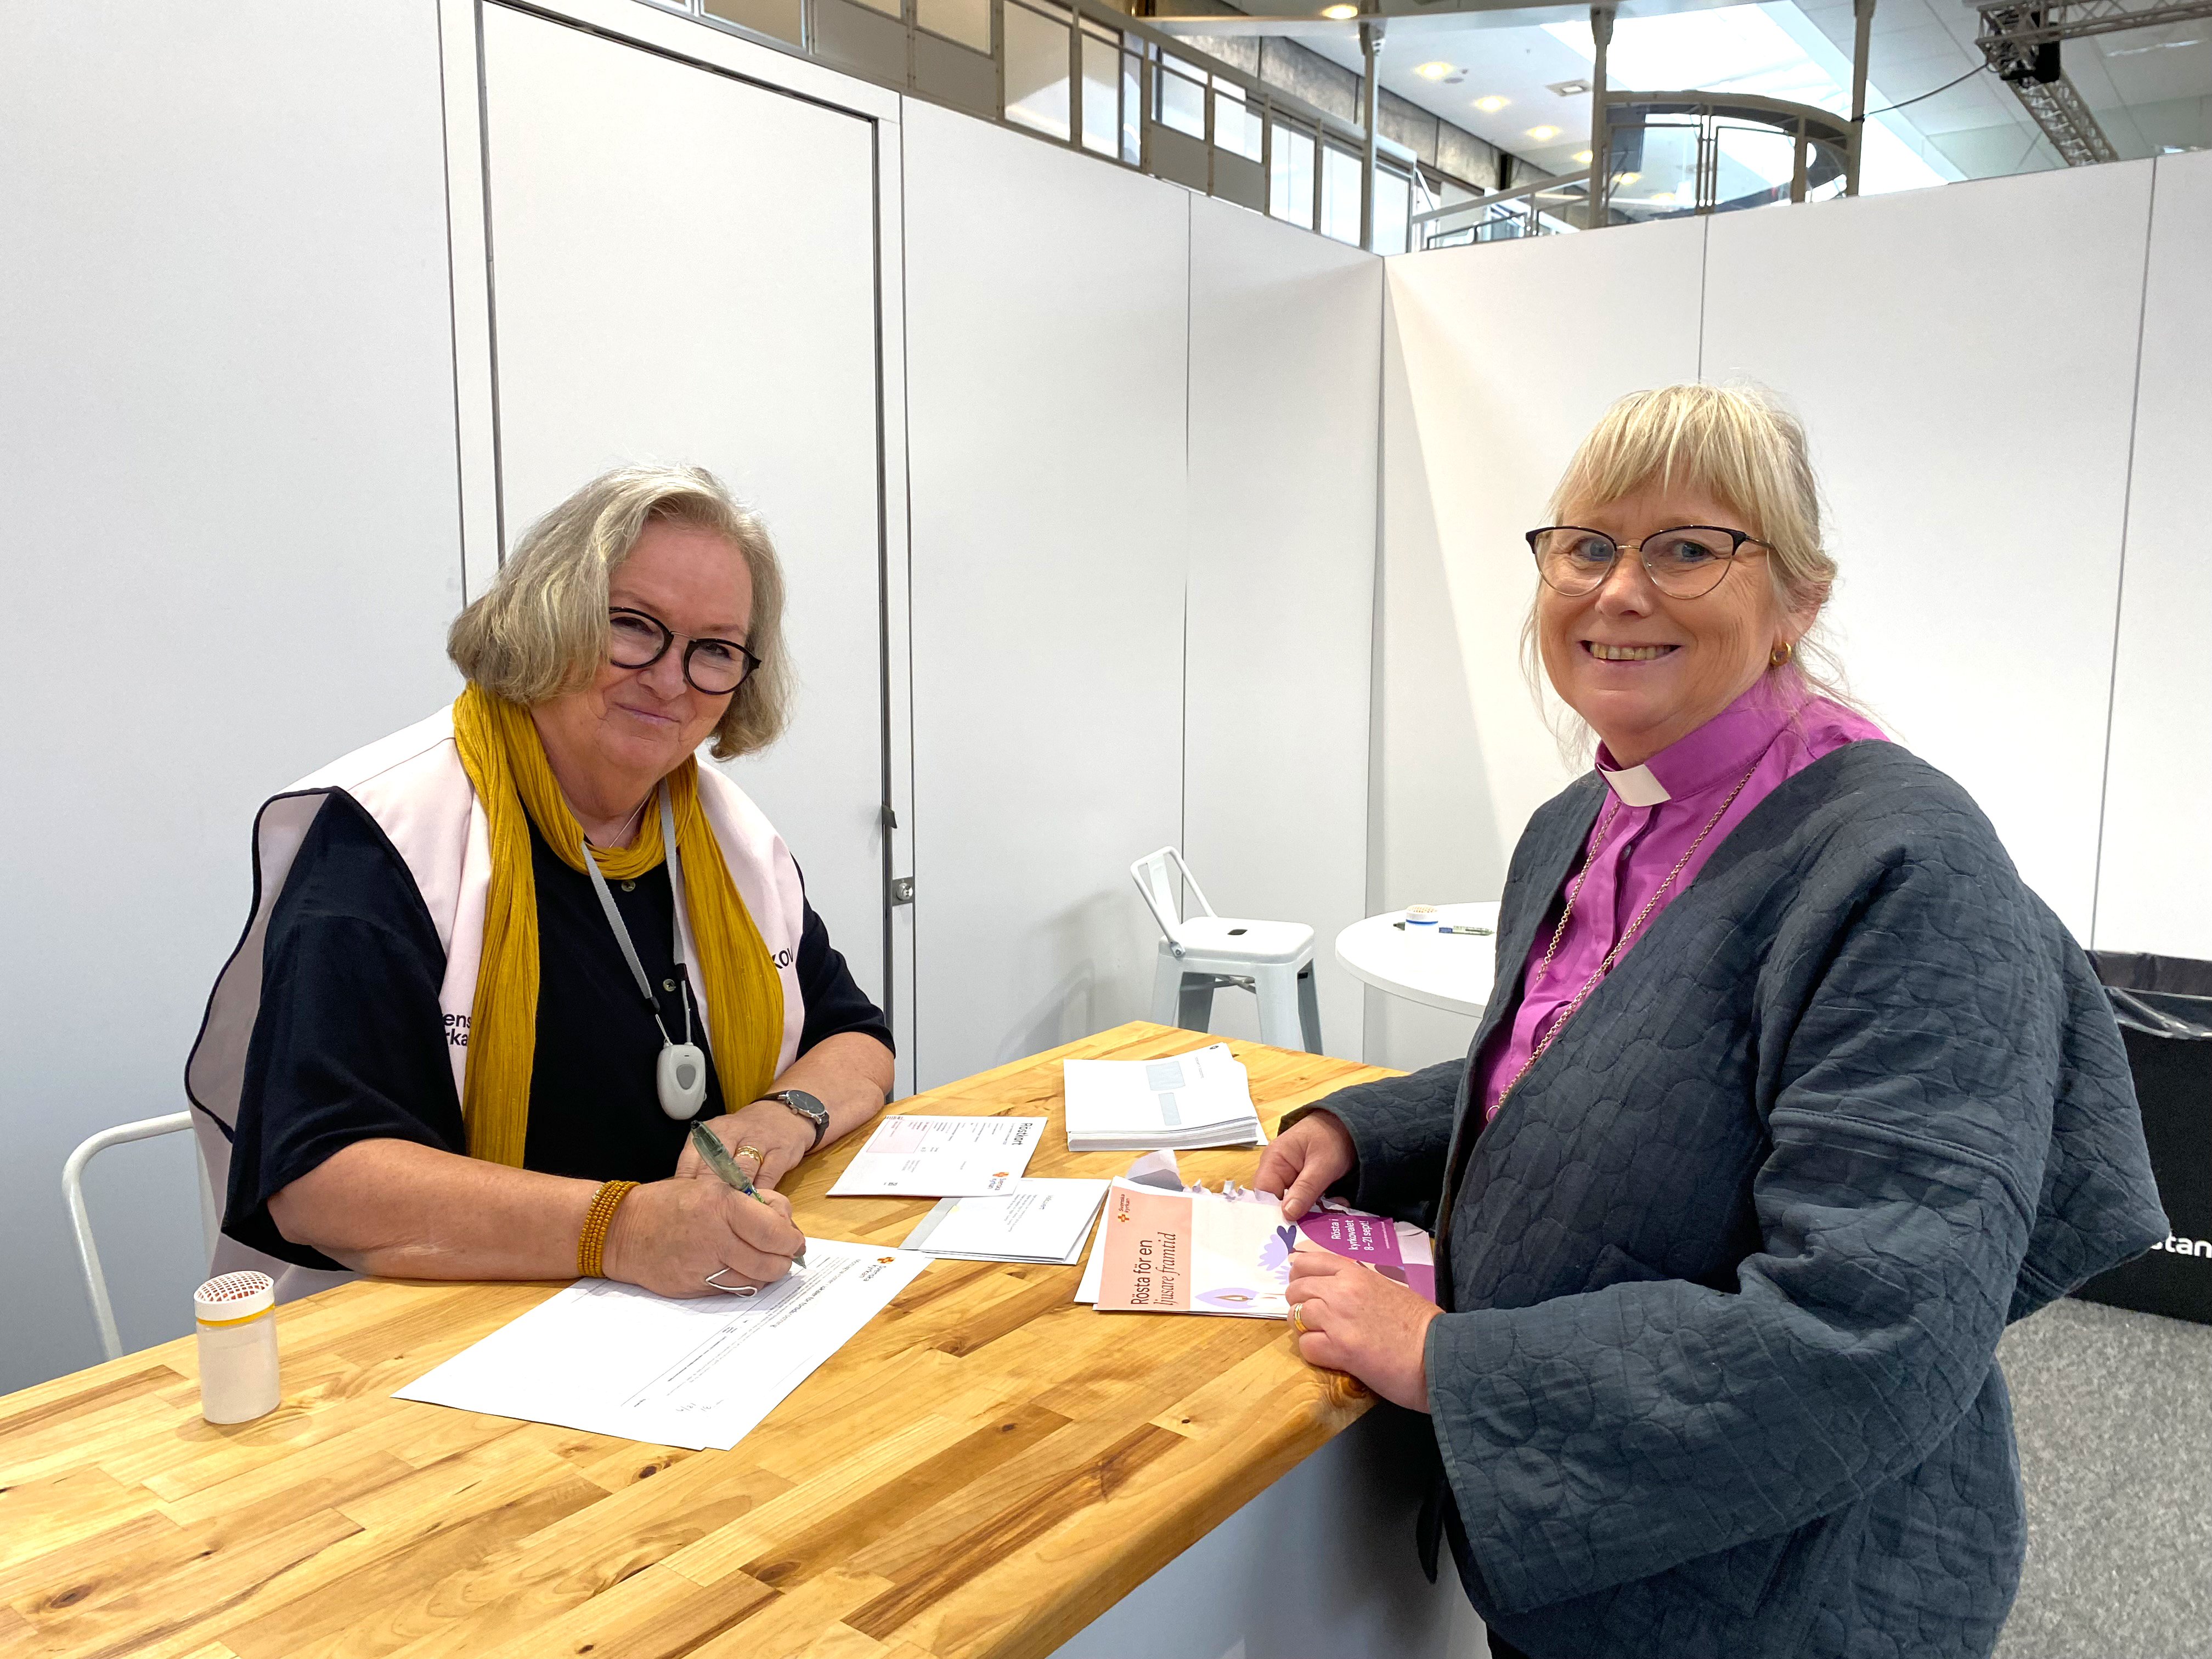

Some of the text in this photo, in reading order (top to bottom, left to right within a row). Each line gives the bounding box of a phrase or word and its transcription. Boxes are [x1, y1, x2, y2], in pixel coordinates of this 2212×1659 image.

[1012, 1123, 1033, 1145] Röstkort
[1330, 1222, 1341, 1240] Rösta
[1345, 1220, 1361, 1250] kyrkovalet
[1359, 1220, 1373, 1236] sept!
[2149, 1231, 2212, 1259] tan
[863, 1265, 887, 1282] Svenska
[1131, 1240, 1153, 1305] Rösta för en
[1153, 1232, 1180, 1306] ljusare framtid
